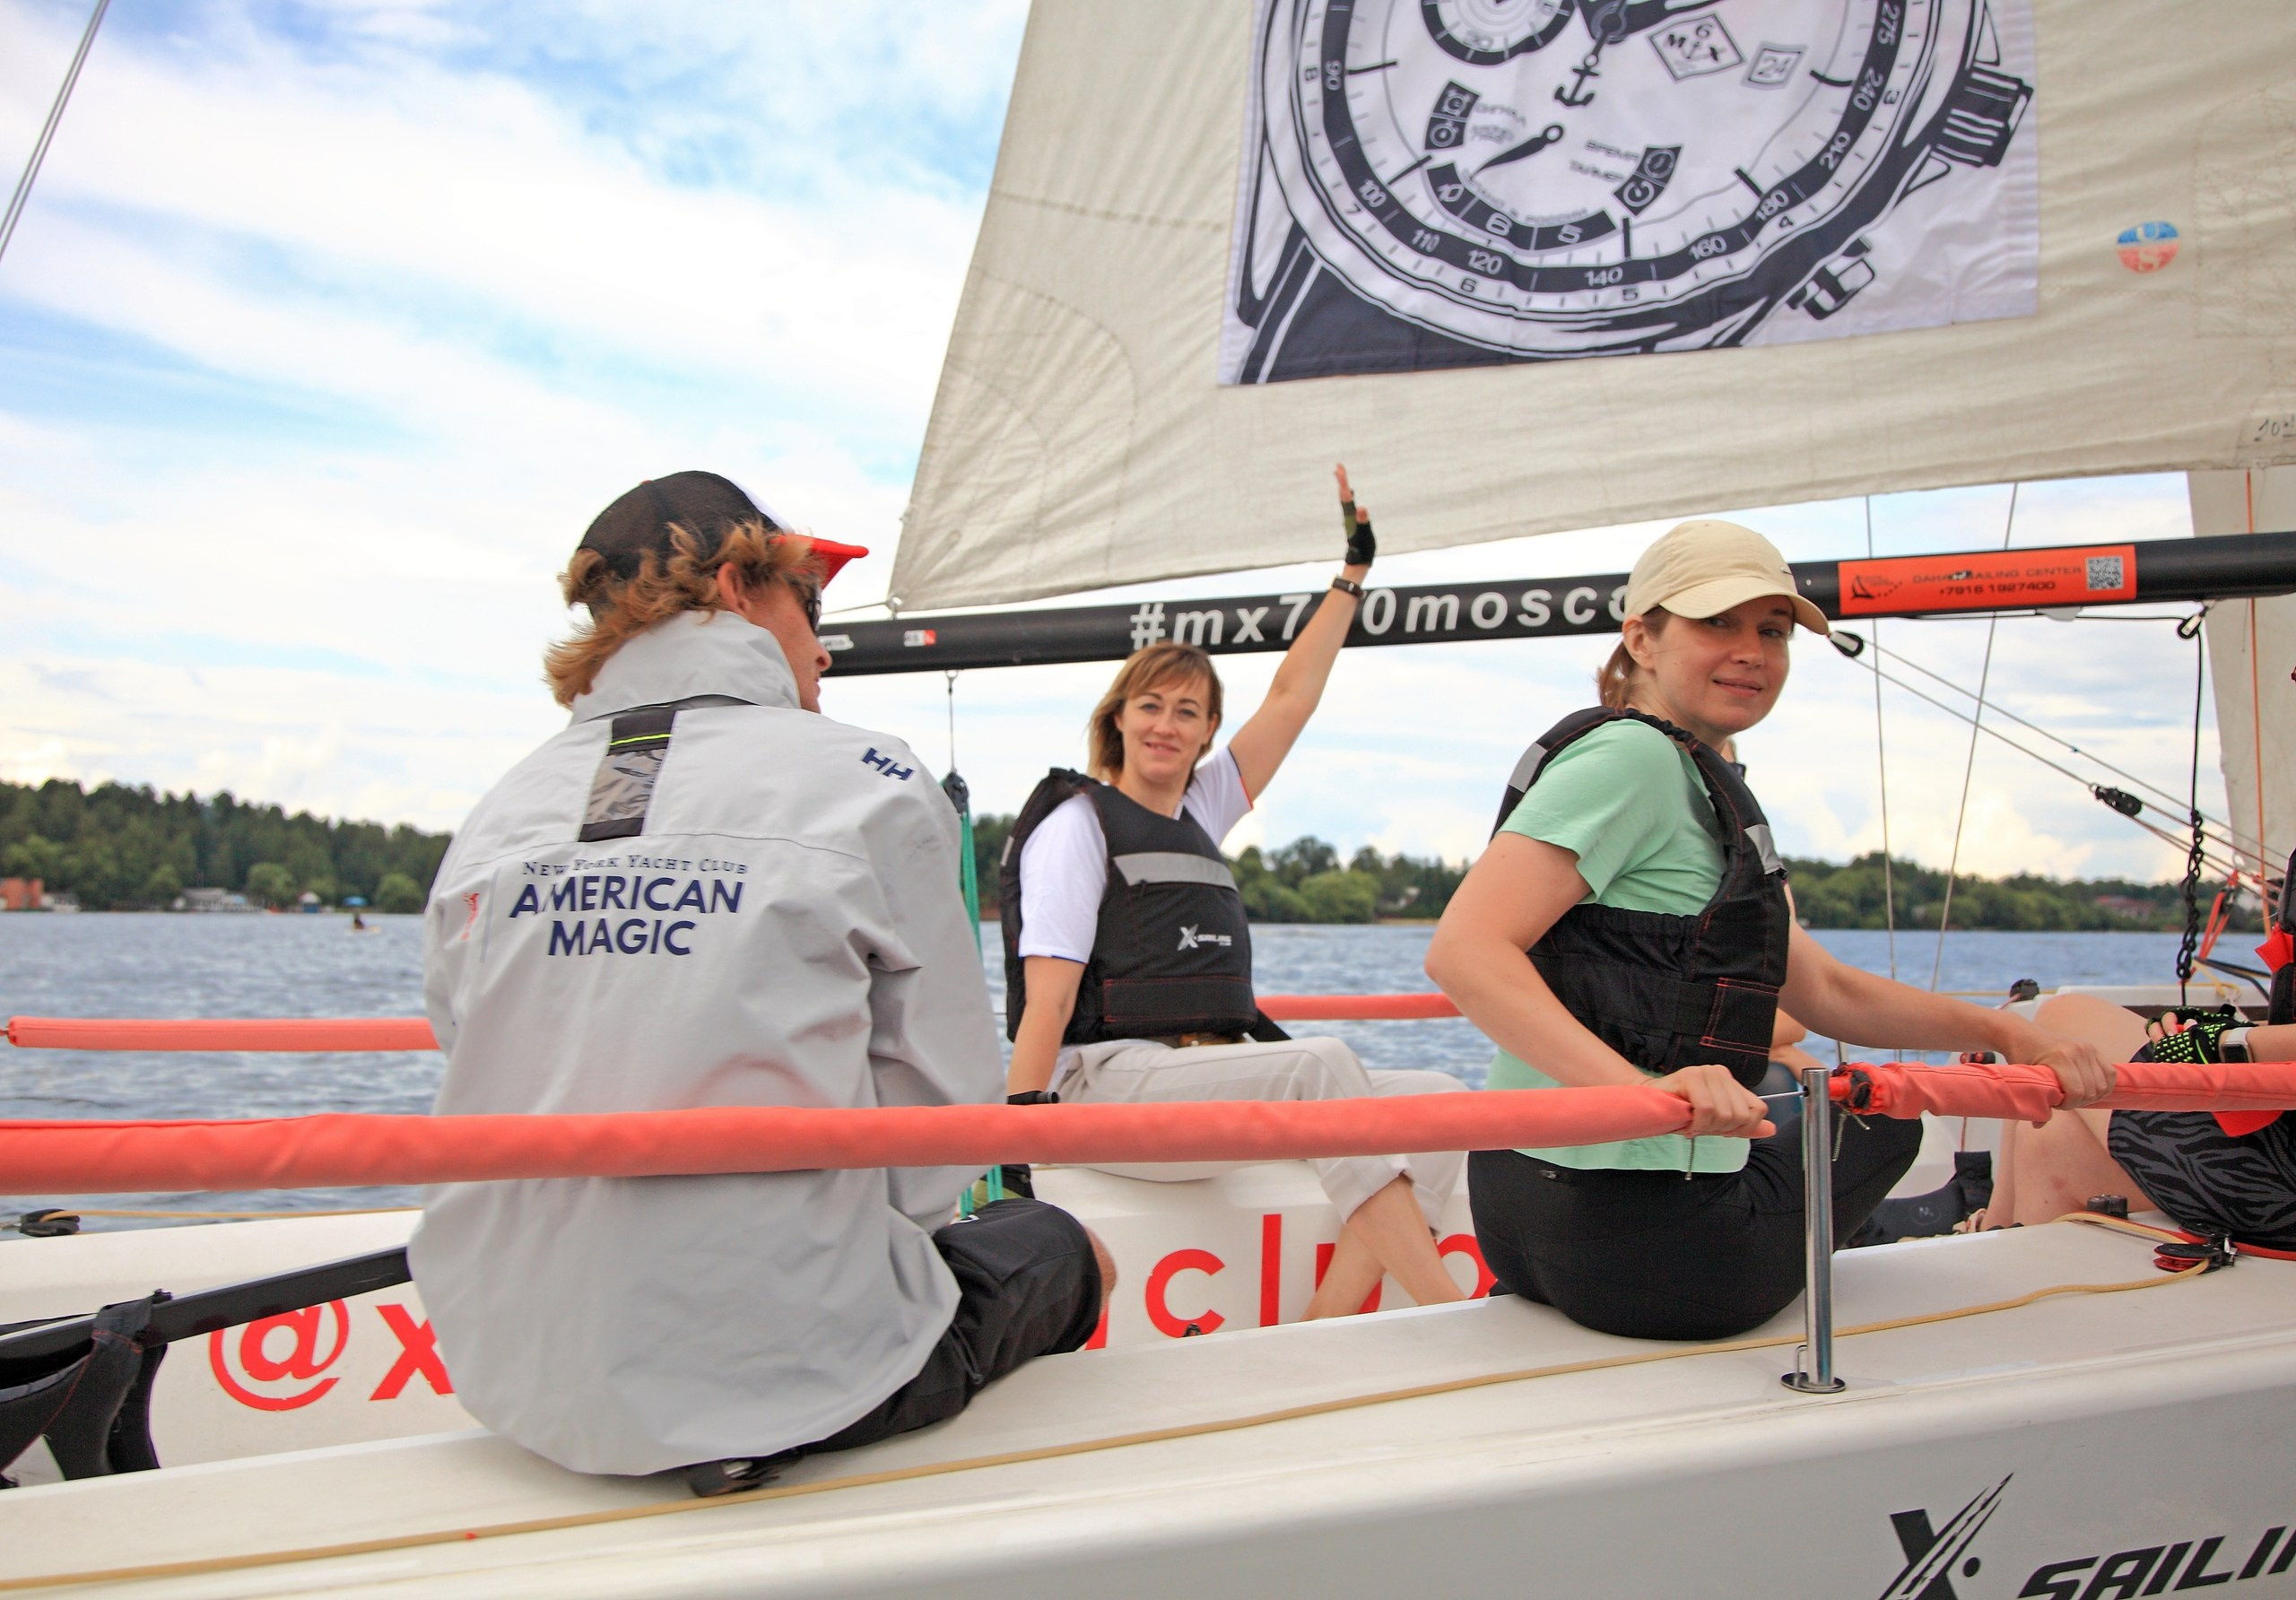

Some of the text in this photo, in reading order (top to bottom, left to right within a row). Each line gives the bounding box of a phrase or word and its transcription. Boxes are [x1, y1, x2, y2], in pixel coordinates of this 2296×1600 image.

[1852, 66, 1884, 111] 240
[1818, 131, 1852, 170] 210
[1358, 179, 1387, 208] 100
[1755, 189, 1790, 222] 180
[1411, 229, 1441, 253] 110
[1689, 234, 1727, 261] 160
[1467, 248, 1503, 275] 120
[1460, 277, 1478, 293] 6
[1584, 265, 1624, 287] 140
[1622, 287, 1639, 301] 5
[2026, 566, 2082, 578] CENTER
[1130, 586, 1629, 651] #mx70mosc
[509, 875, 744, 918] AMERICAN
[547, 917, 697, 957] MAGIC
